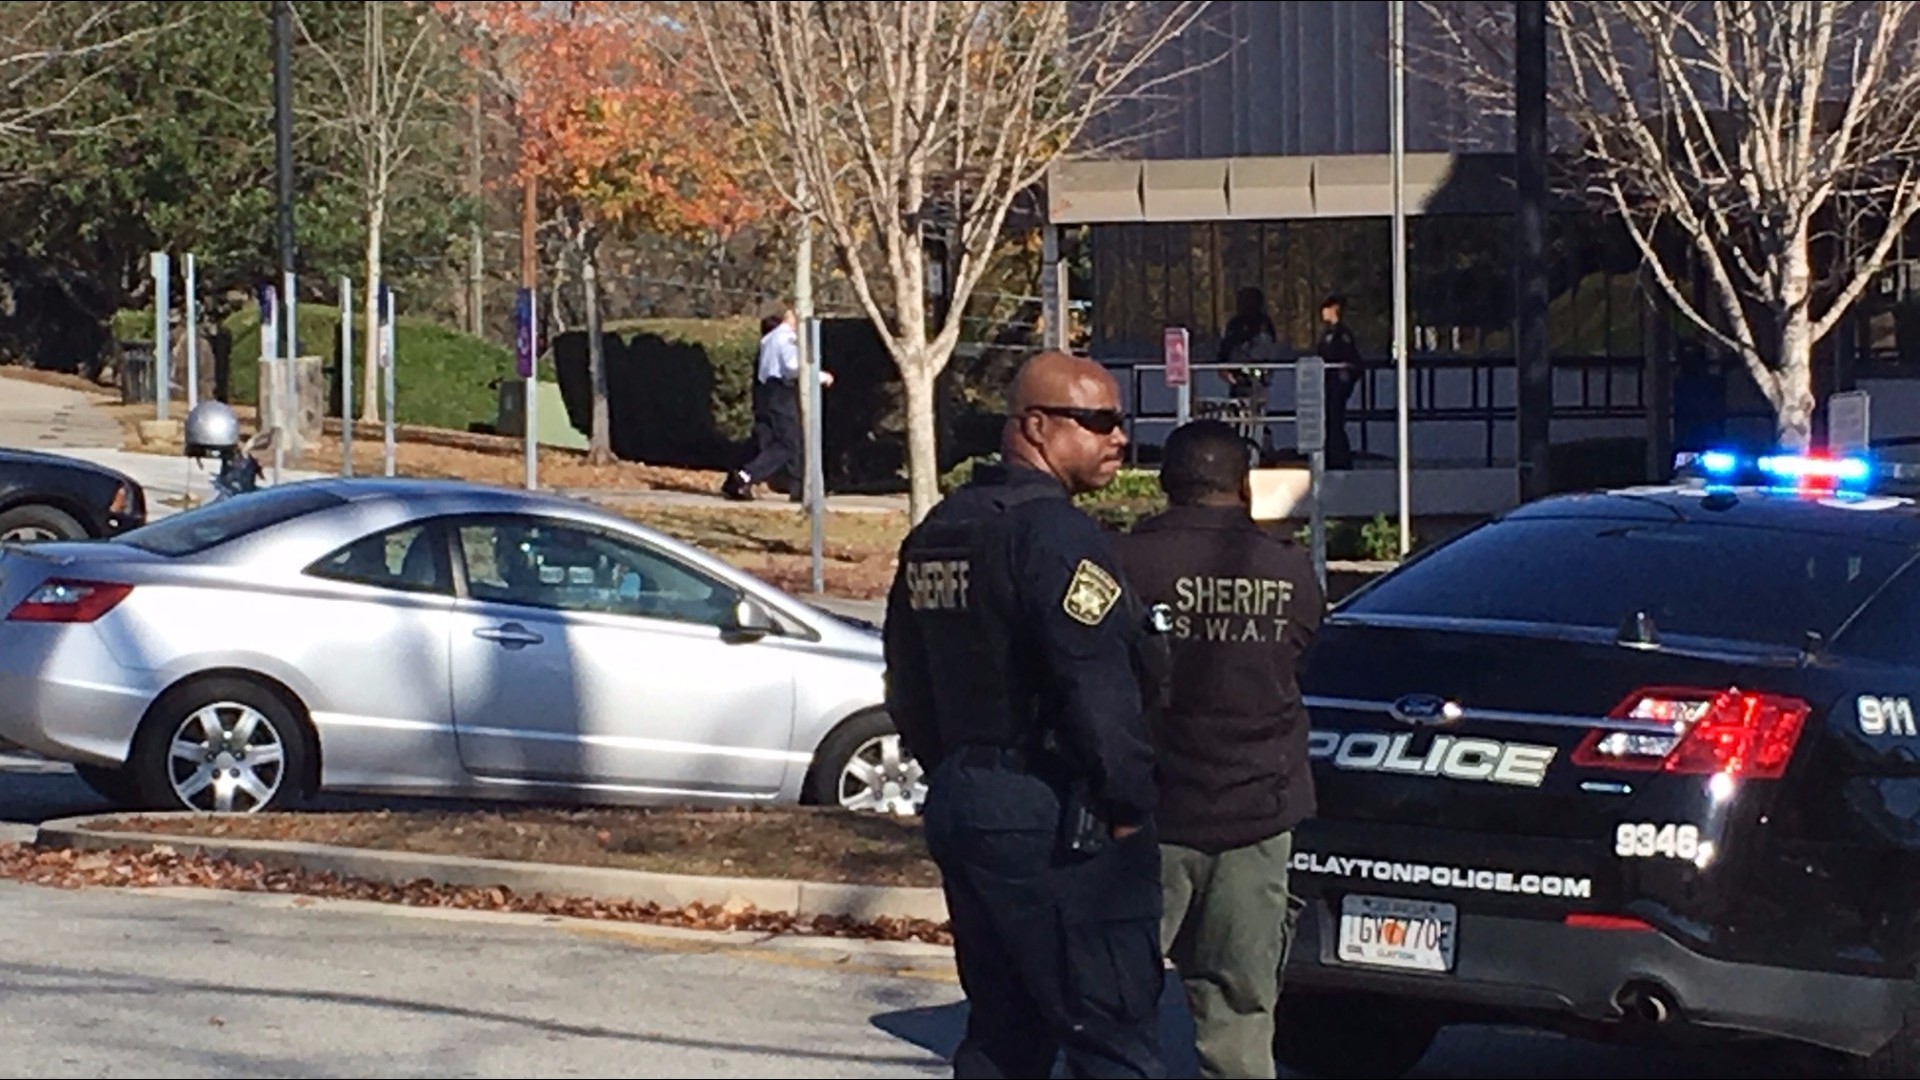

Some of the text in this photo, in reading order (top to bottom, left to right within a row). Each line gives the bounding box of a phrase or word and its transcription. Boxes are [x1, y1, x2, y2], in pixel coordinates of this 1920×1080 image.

[906, 560, 969, 610] SHERIFF
[1175, 576, 1294, 615] SHERIFF
[1857, 695, 1918, 736] 911
[1307, 730, 1558, 787] POLICE
[1615, 823, 1699, 859] 9346
